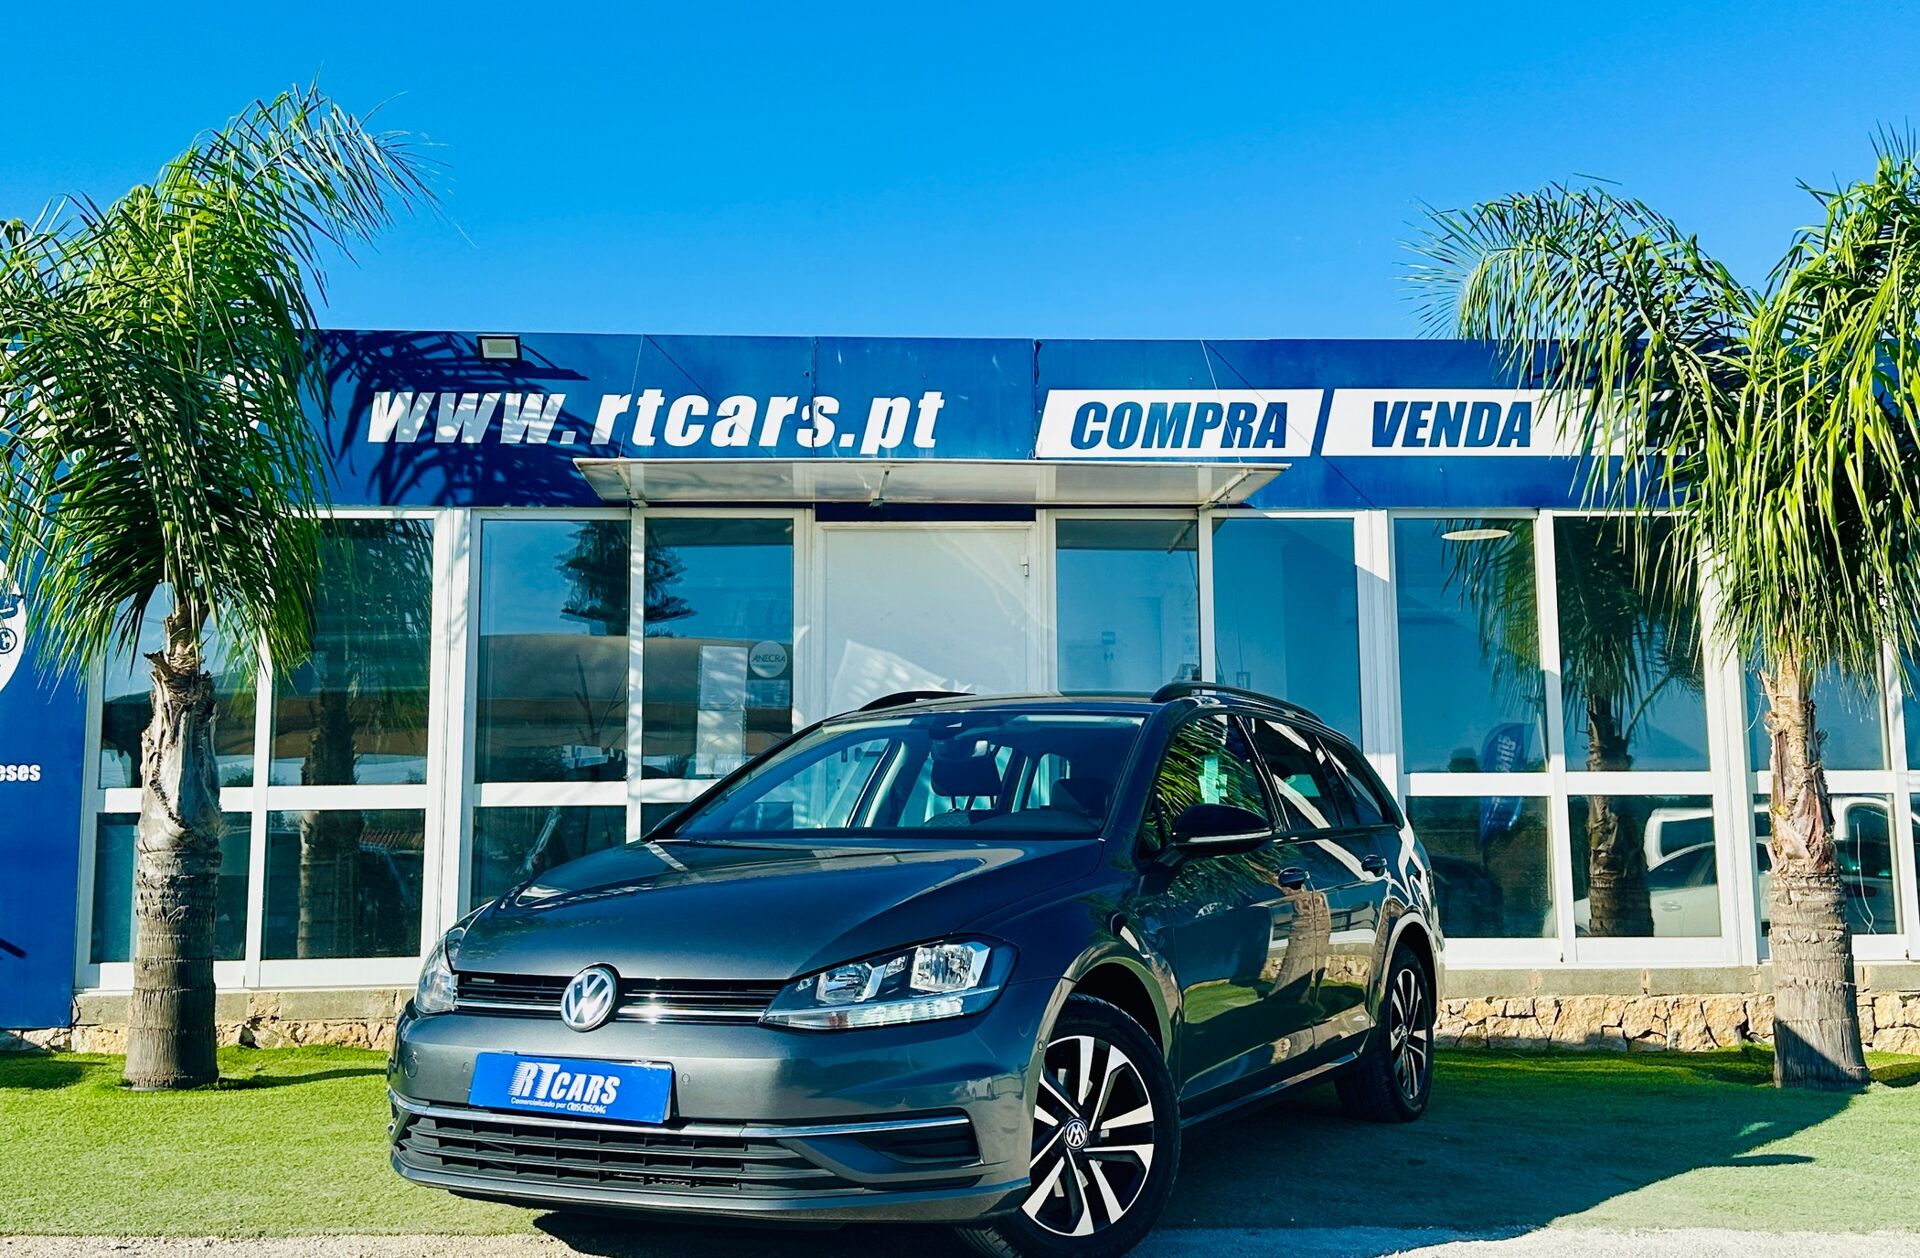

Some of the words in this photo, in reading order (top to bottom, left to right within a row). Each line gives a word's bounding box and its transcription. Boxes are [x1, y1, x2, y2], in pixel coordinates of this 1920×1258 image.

[368, 389, 944, 454] www.rtcars.pt
[1070, 401, 1287, 450] COMPRA
[1371, 401, 1531, 448] VENDA
[555, 1102, 567, 1110] por
